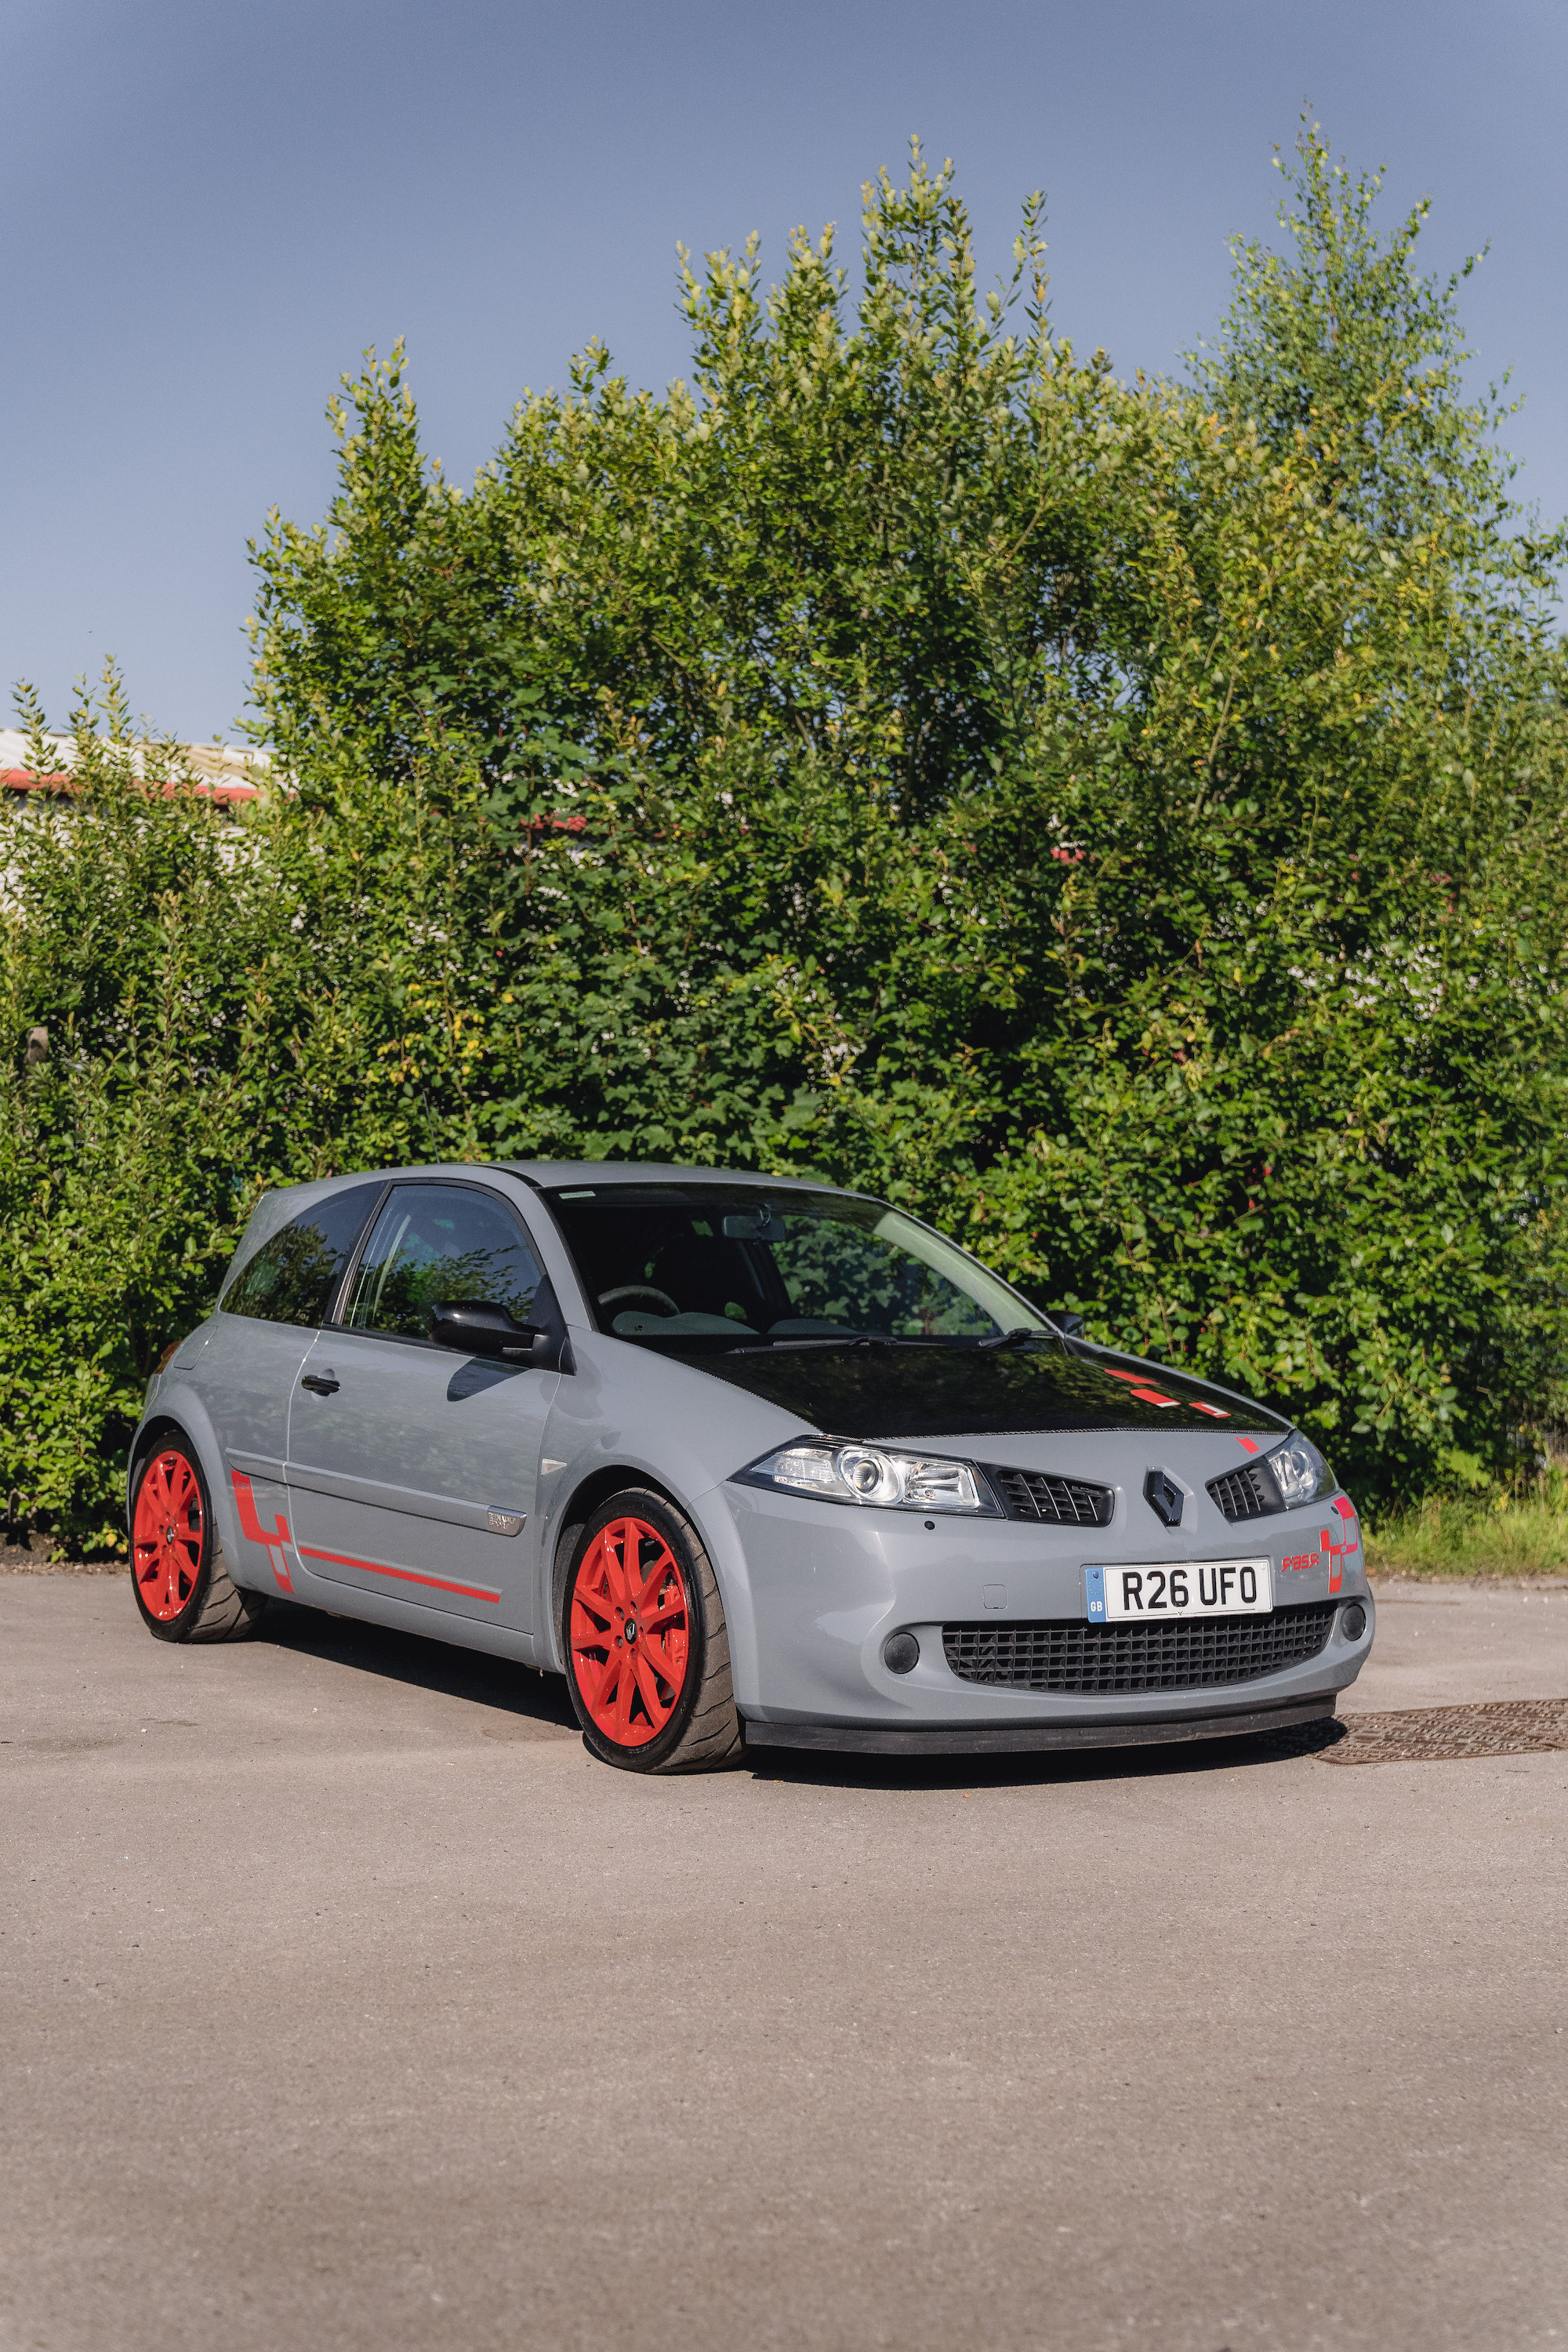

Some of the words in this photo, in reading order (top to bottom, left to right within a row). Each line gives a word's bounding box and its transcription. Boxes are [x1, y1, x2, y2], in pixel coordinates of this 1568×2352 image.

[1122, 1570, 1189, 1610] R26
[1199, 1566, 1257, 1606] UFO
[1090, 1600, 1103, 1613] GB
